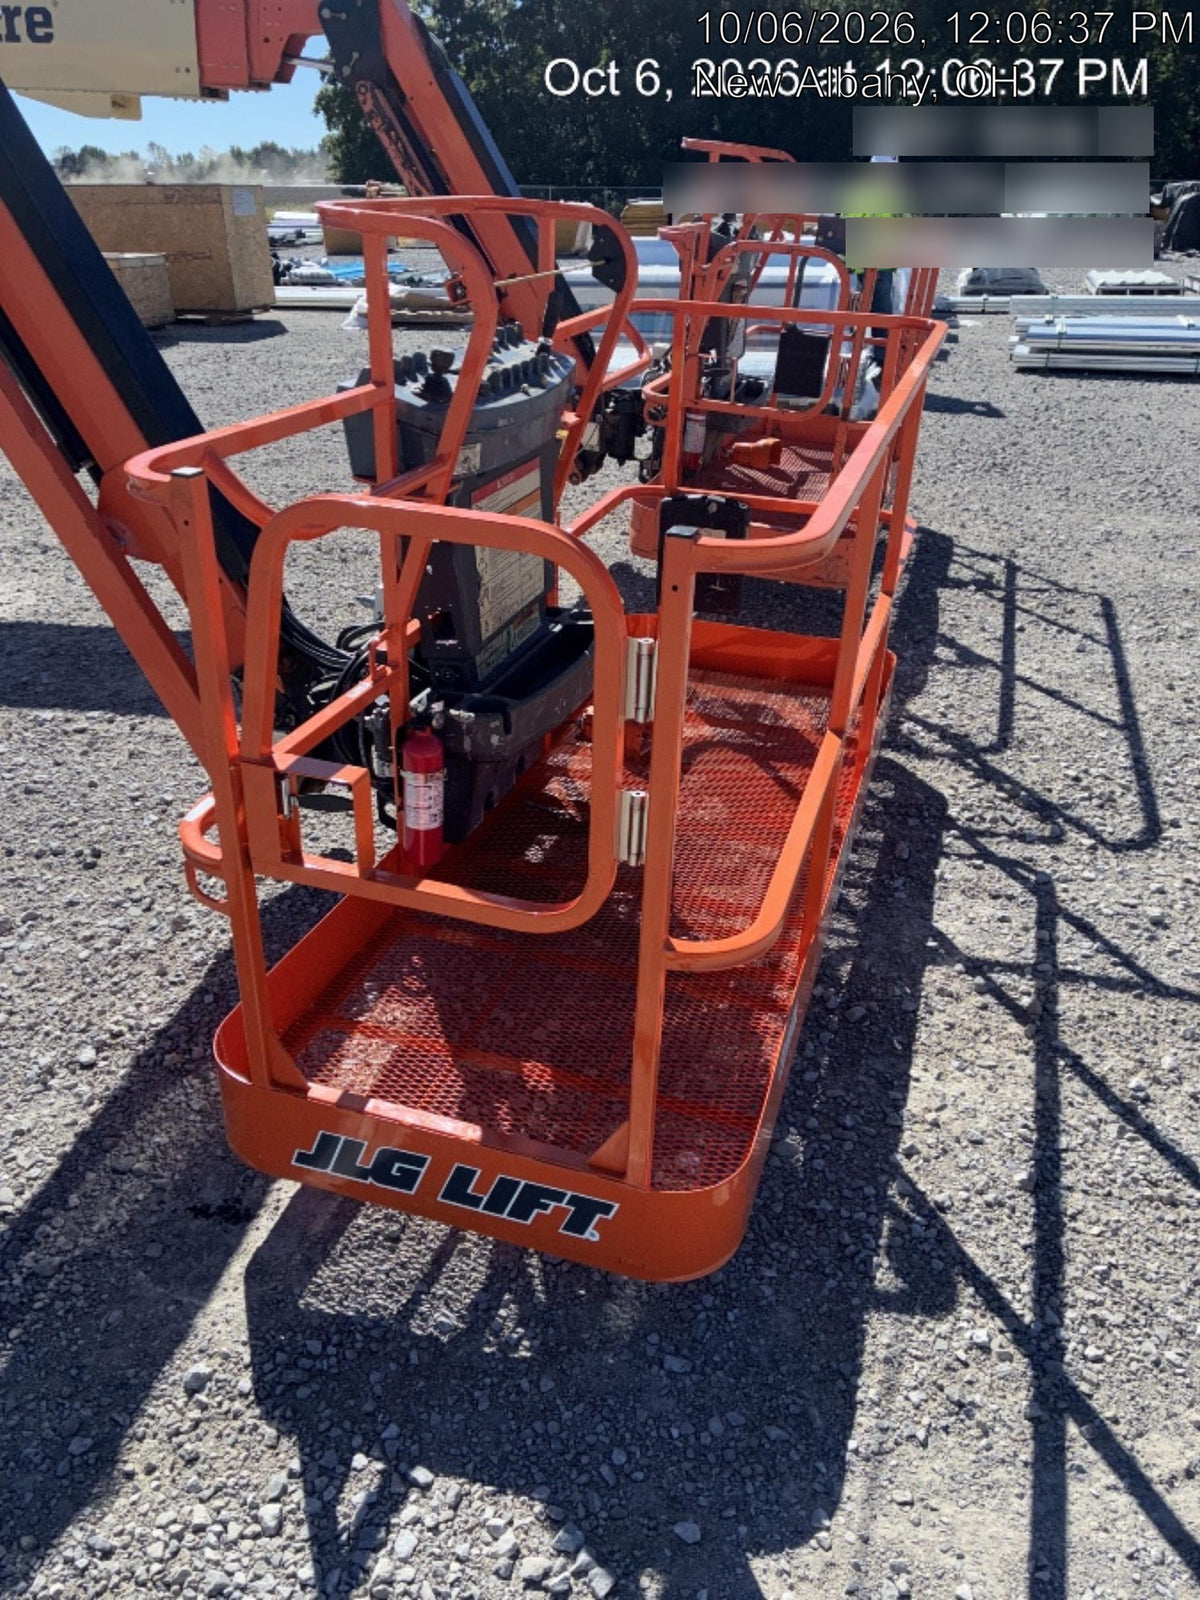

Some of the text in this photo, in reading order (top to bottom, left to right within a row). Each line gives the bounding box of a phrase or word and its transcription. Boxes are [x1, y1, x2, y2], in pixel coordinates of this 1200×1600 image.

[0, 5, 54, 43] re
[291, 1130, 620, 1239] JLG LIFT
